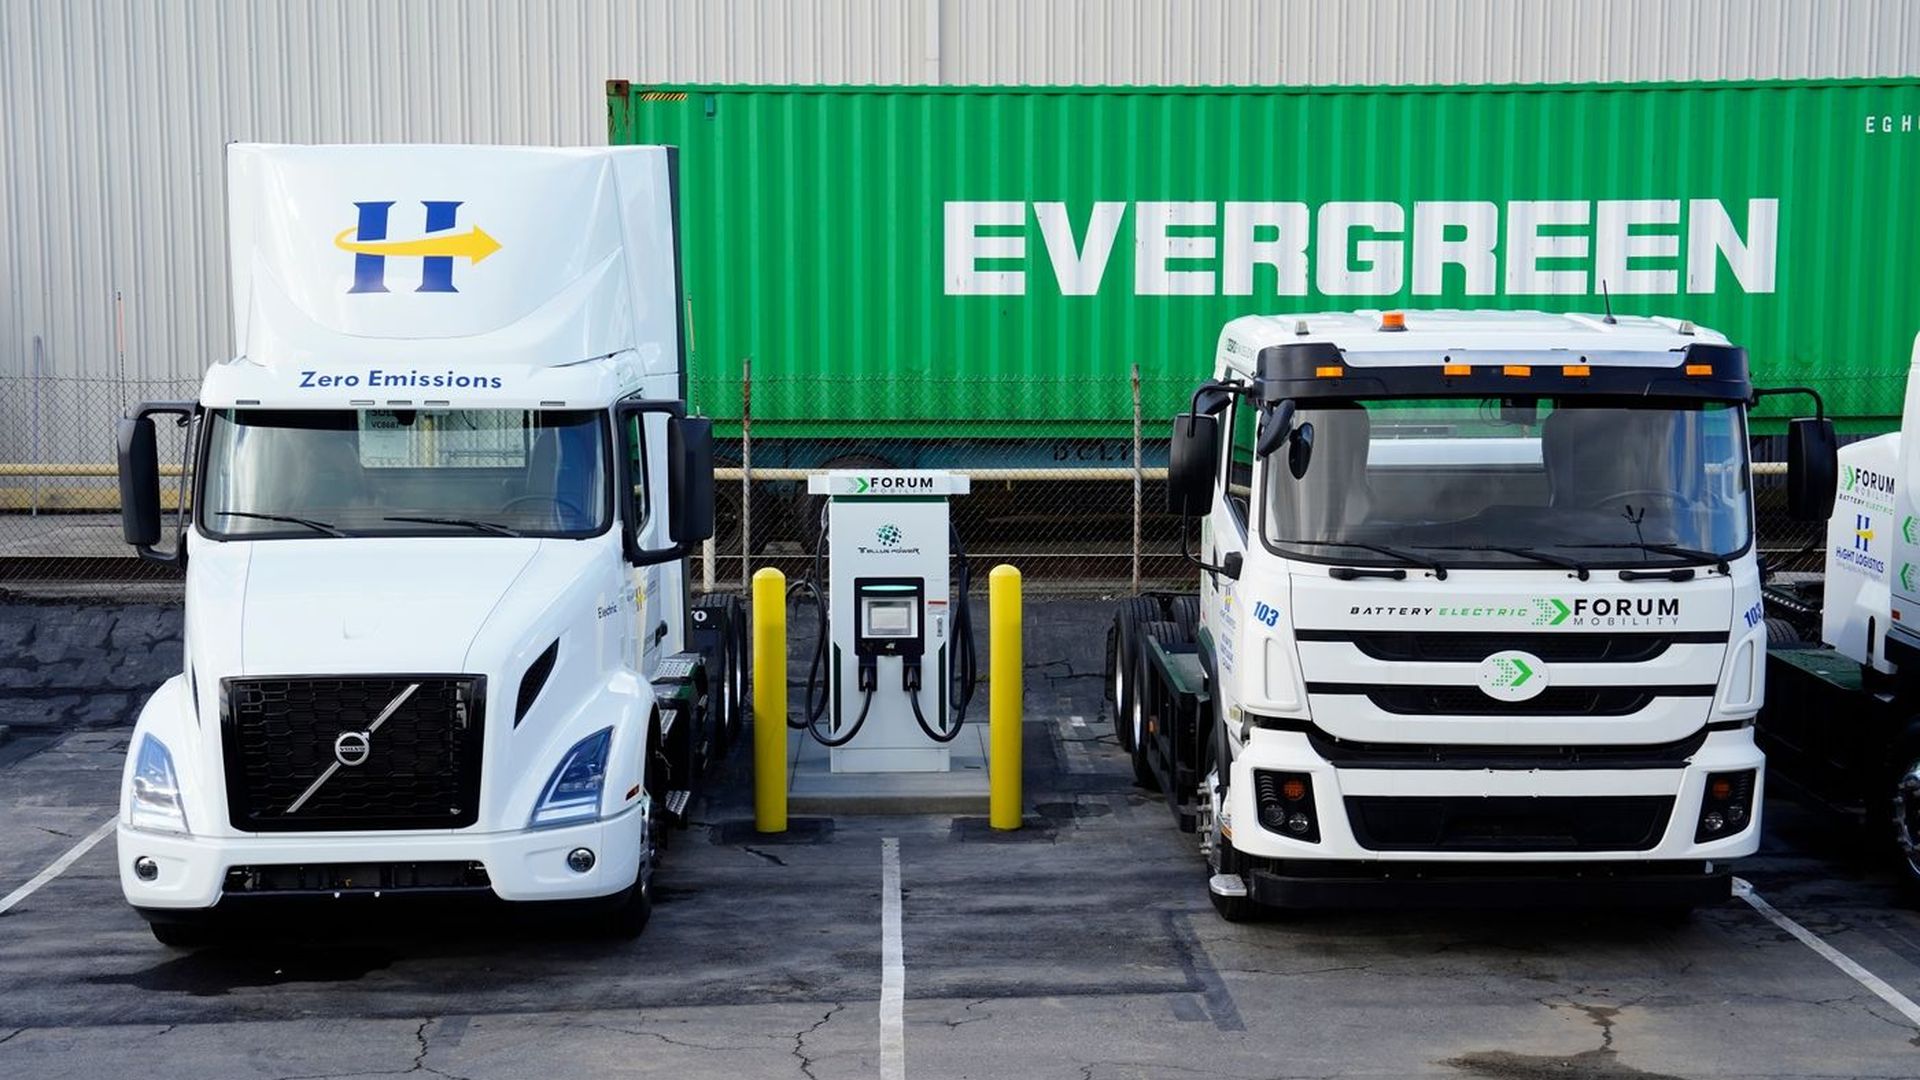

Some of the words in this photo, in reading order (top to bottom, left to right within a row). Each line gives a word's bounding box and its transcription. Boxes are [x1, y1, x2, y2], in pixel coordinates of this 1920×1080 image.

[1865, 115, 1920, 133] EGH
[943, 198, 1779, 297] EVERGREEN
[299, 371, 360, 388] Zero
[368, 370, 502, 389] Emissions
[870, 477, 934, 488] FORUM
[1855, 468, 1895, 495] FORUM
[1253, 601, 1280, 627] 103
[1350, 606, 1433, 615] BATTERY
[1439, 607, 1528, 616] ELECTRIC
[1574, 599, 1679, 616] FORUM
[1744, 602, 1762, 628] 103
[1574, 617, 1679, 626] MOBILITY
